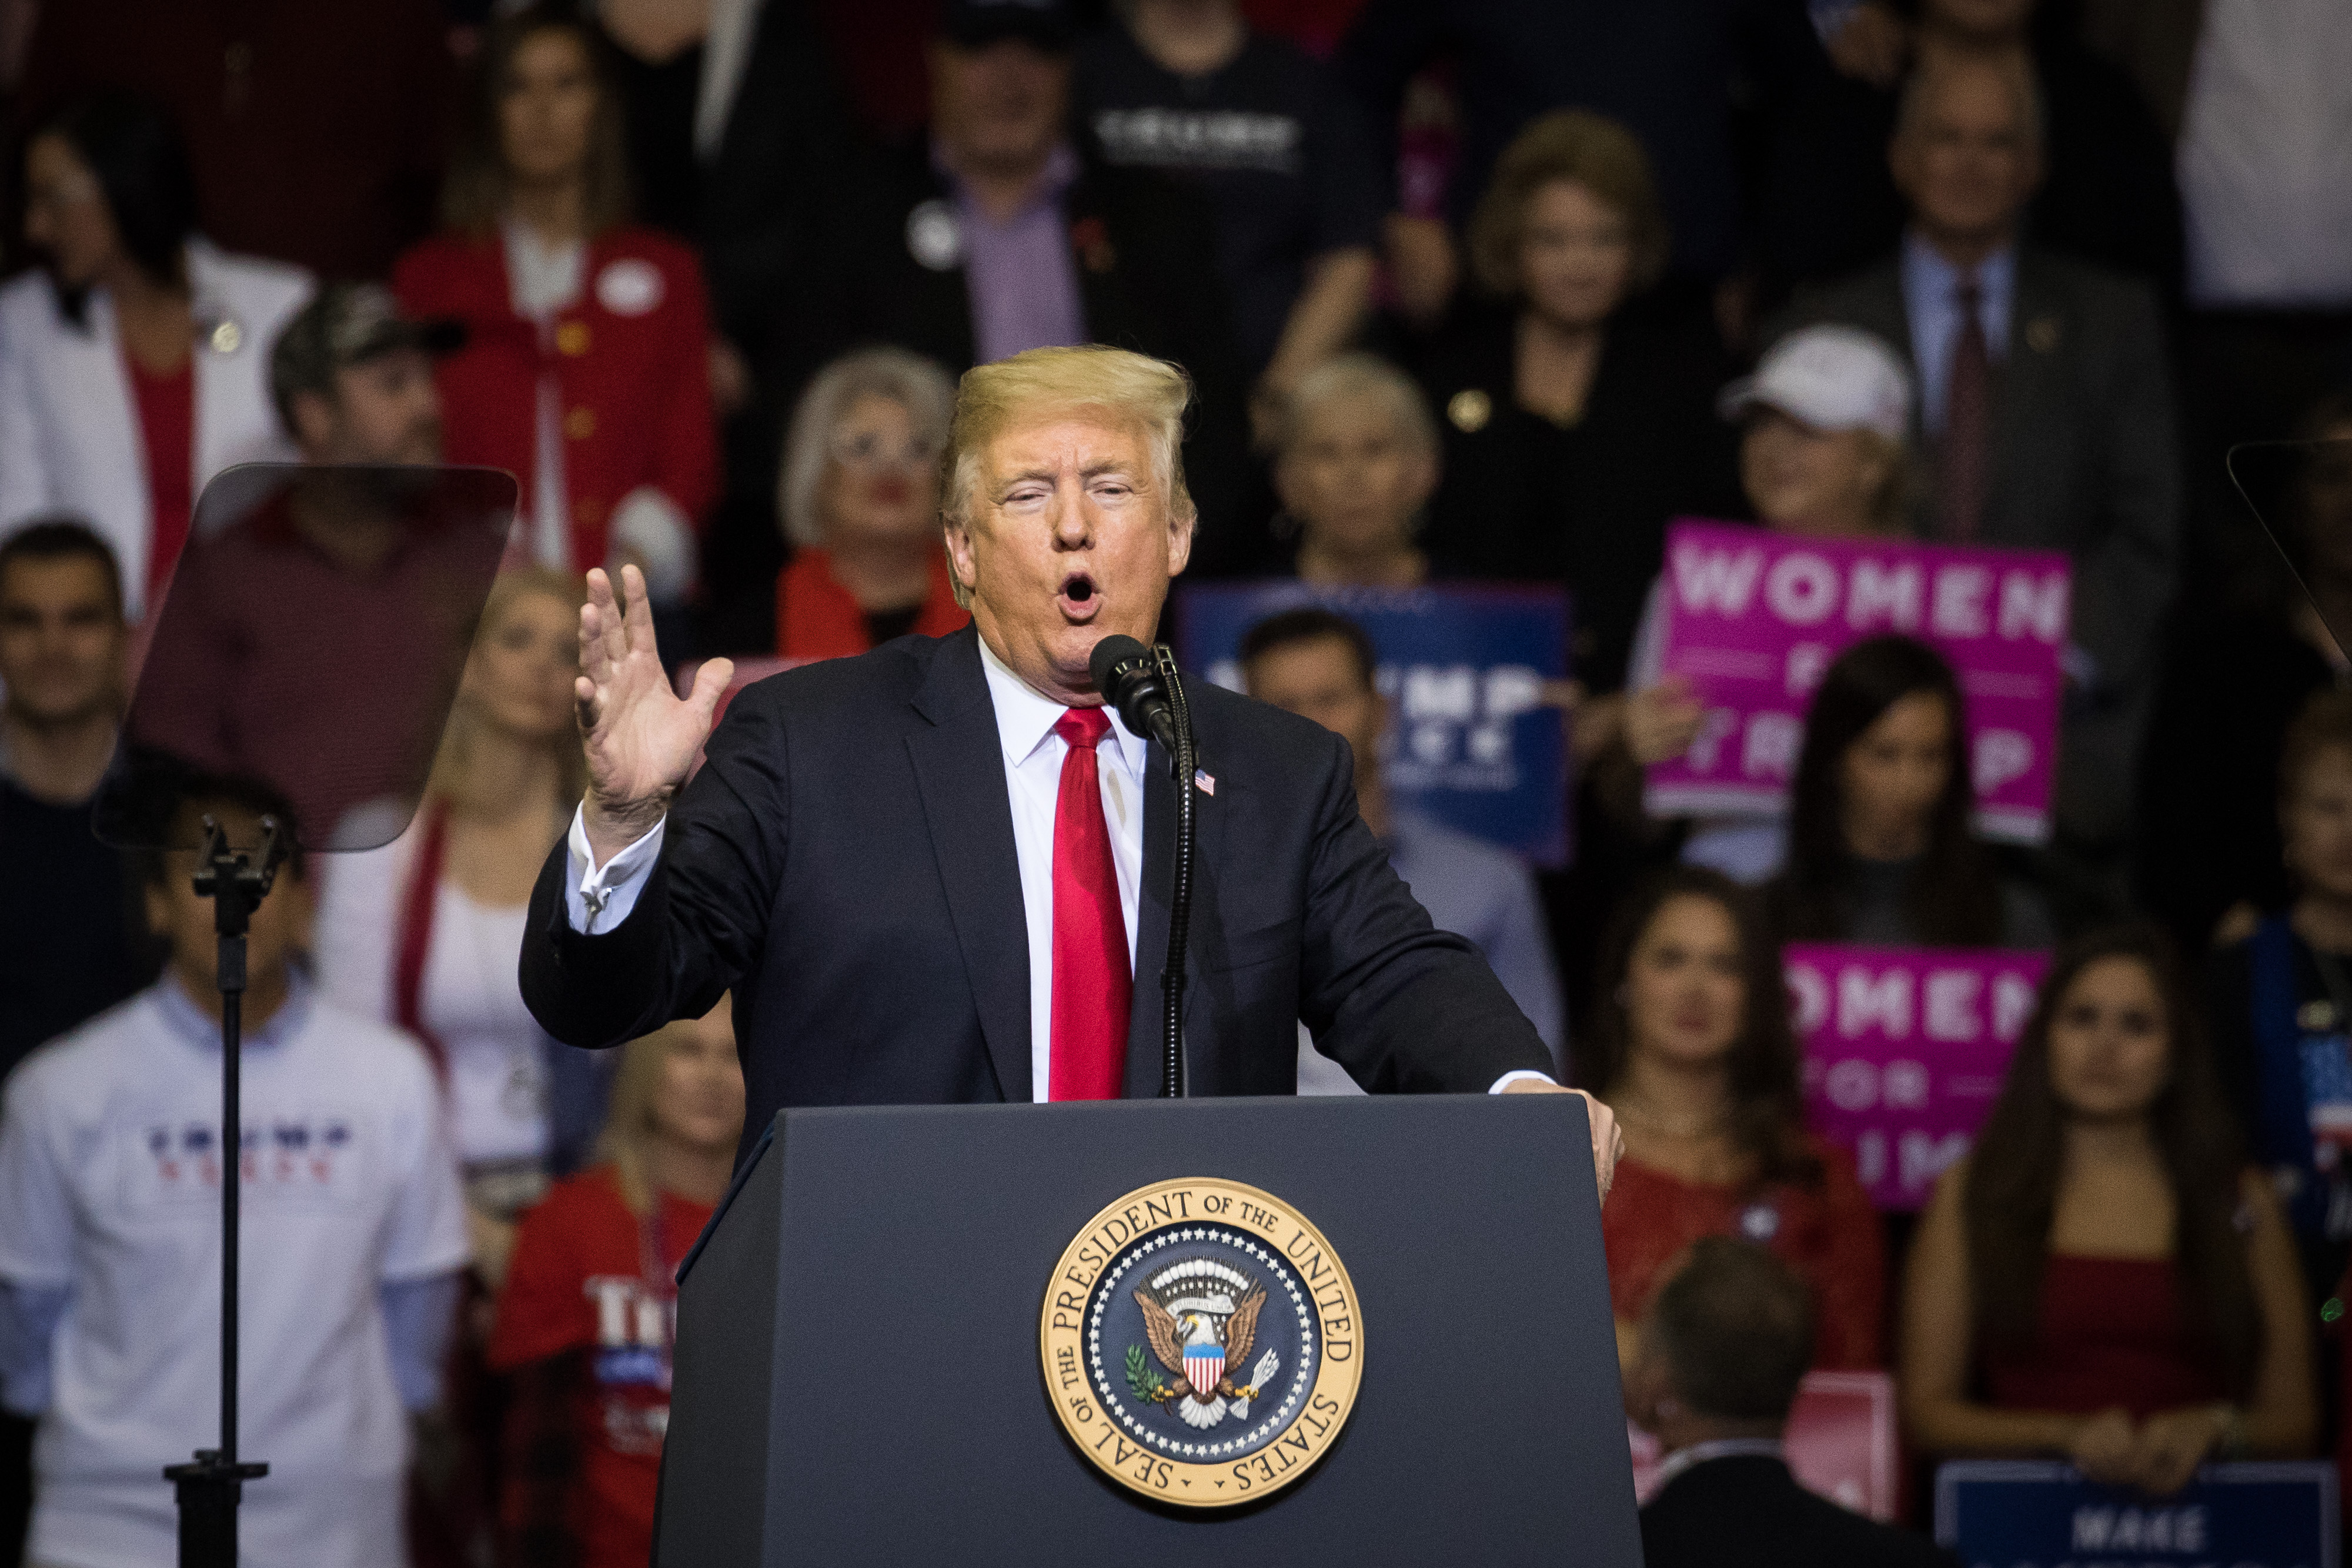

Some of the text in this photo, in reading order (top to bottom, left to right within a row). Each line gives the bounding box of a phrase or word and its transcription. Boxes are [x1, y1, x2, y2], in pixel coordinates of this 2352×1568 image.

[1671, 540, 2066, 642] WOMEN
[1053, 1192, 1352, 1490] SEAL OF THE PRESIDENT OF THE UNITED STATES
